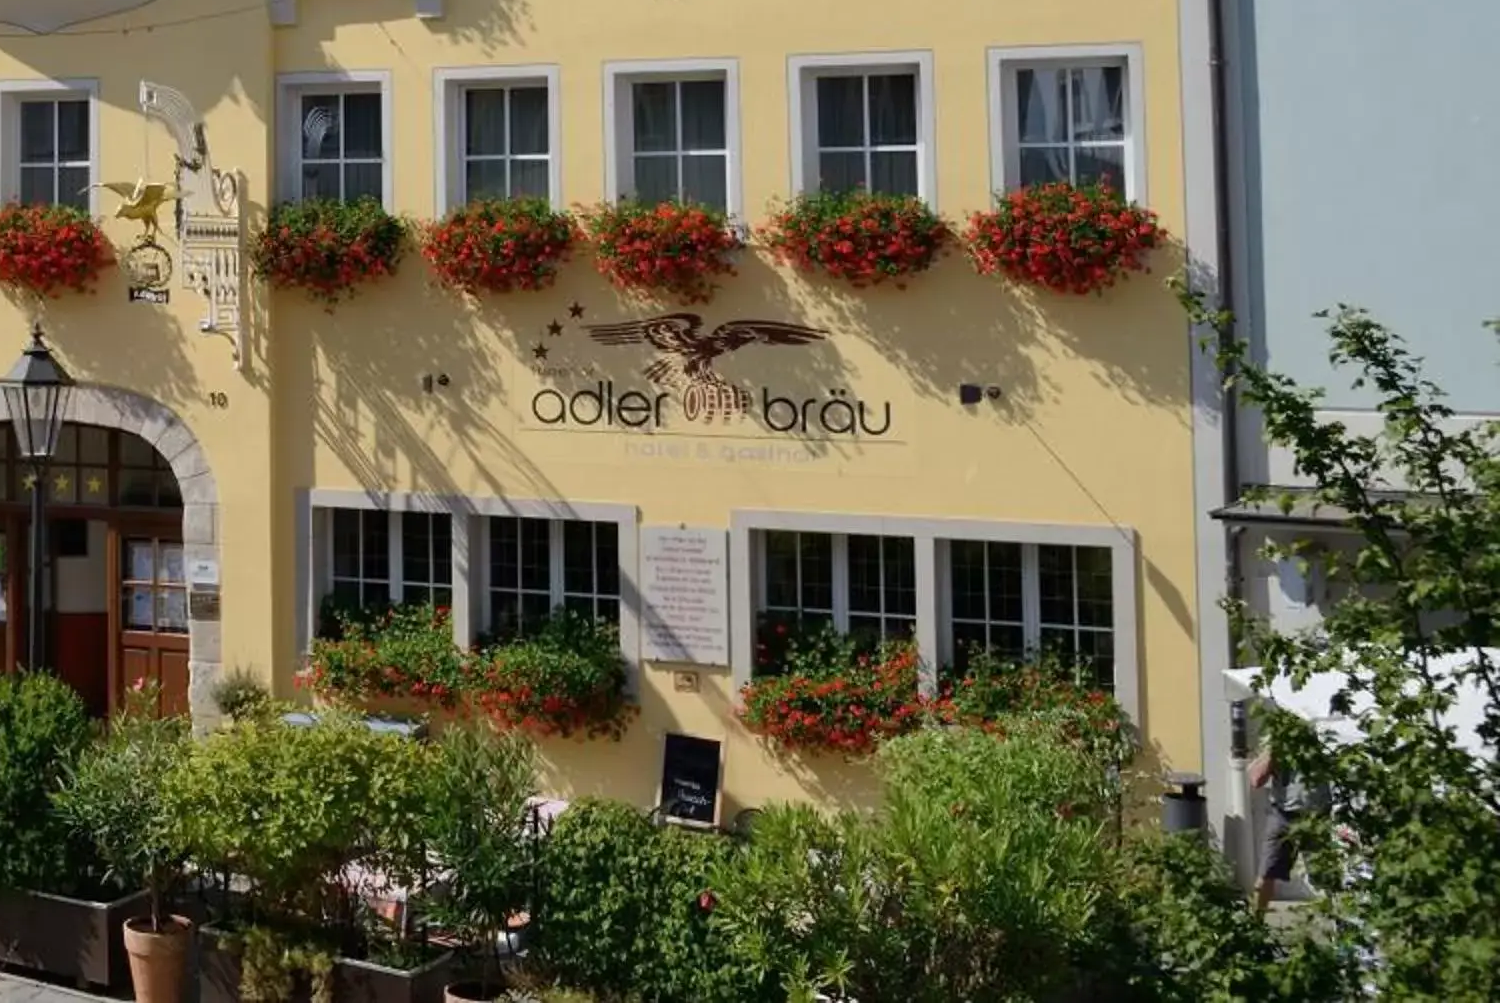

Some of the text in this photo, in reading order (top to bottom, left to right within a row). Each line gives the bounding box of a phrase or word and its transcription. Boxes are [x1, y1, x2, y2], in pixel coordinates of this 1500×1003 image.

[209, 392, 229, 408] 10
[531, 380, 893, 436] adler bräu
